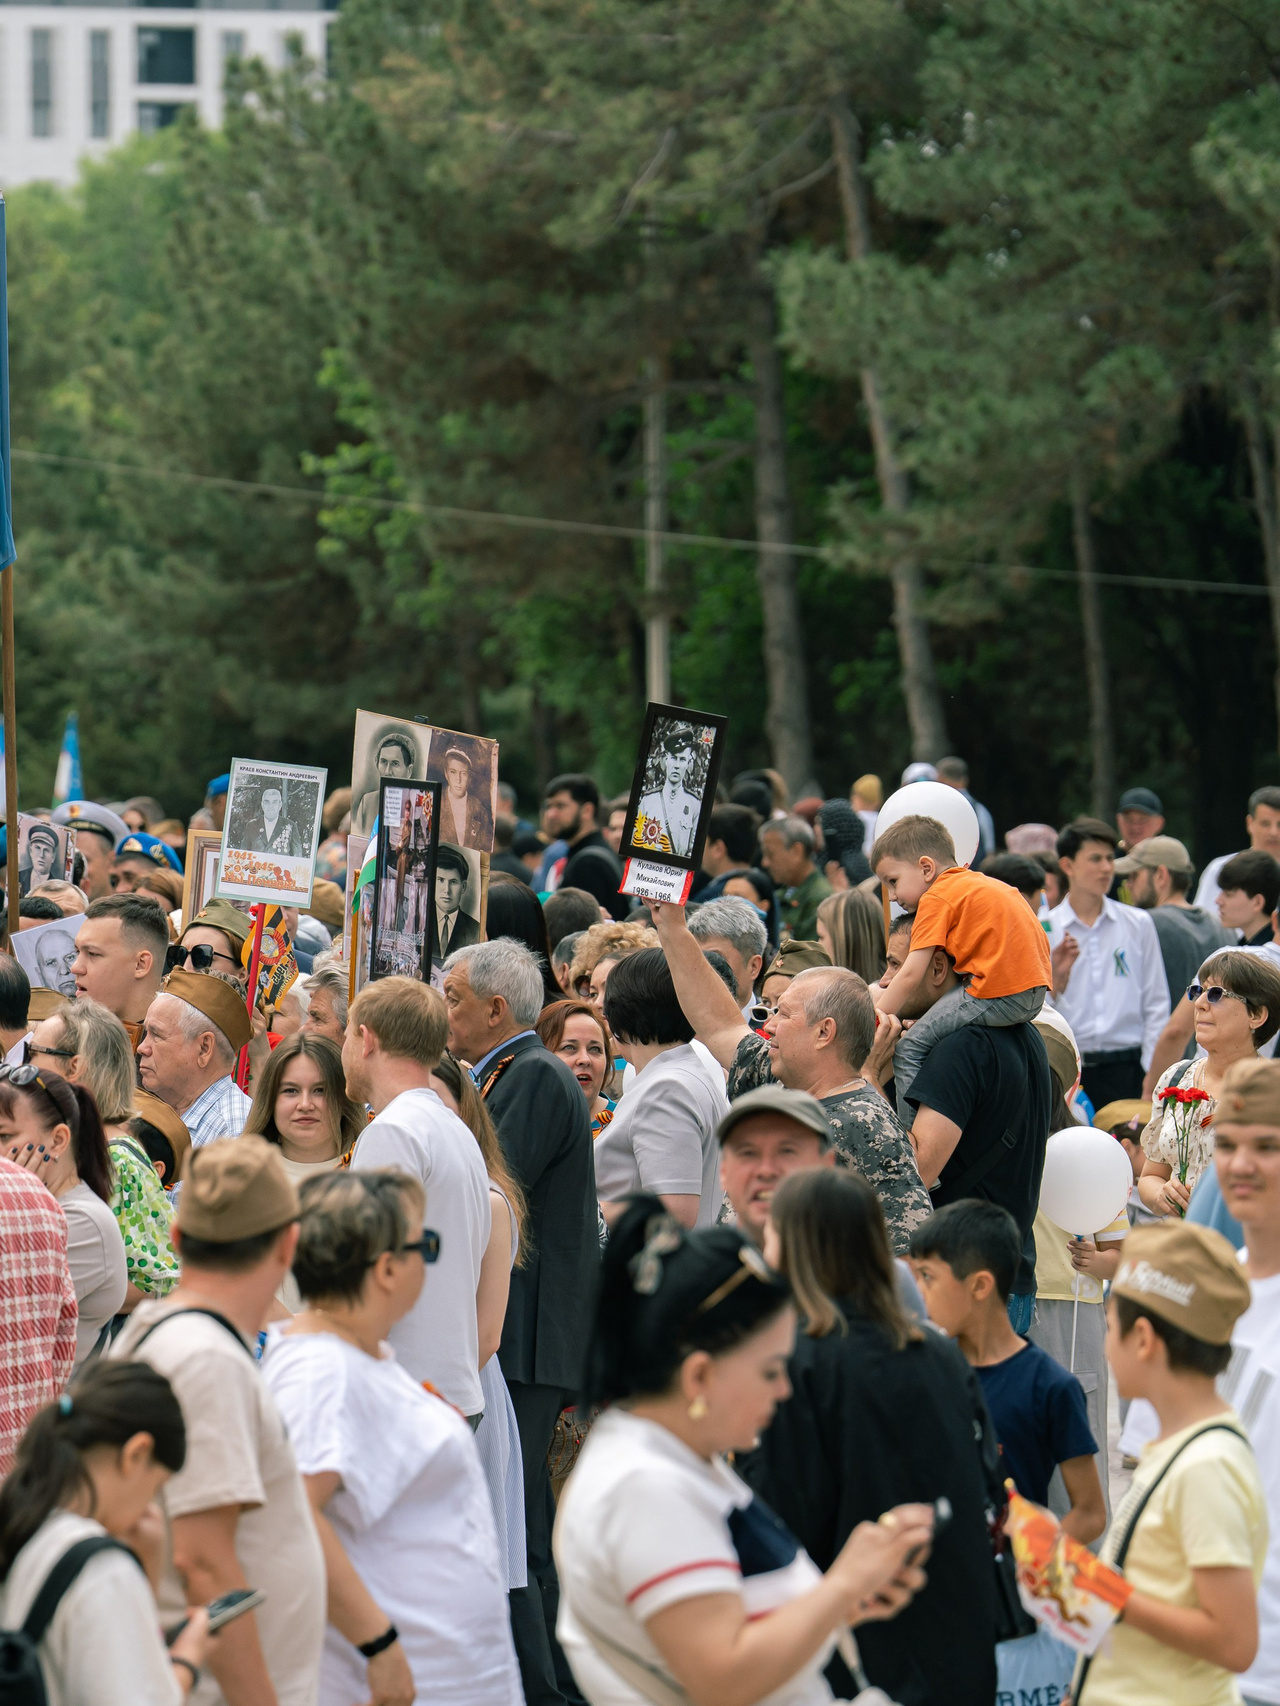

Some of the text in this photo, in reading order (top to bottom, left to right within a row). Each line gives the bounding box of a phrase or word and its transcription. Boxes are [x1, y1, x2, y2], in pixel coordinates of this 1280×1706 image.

[256, 768, 288, 776] КОНСТАНТИН
[227, 850, 257, 860] 1941-
[637, 860, 683, 877] Кулаков Юрий
[636, 873, 675, 888] Михайлович
